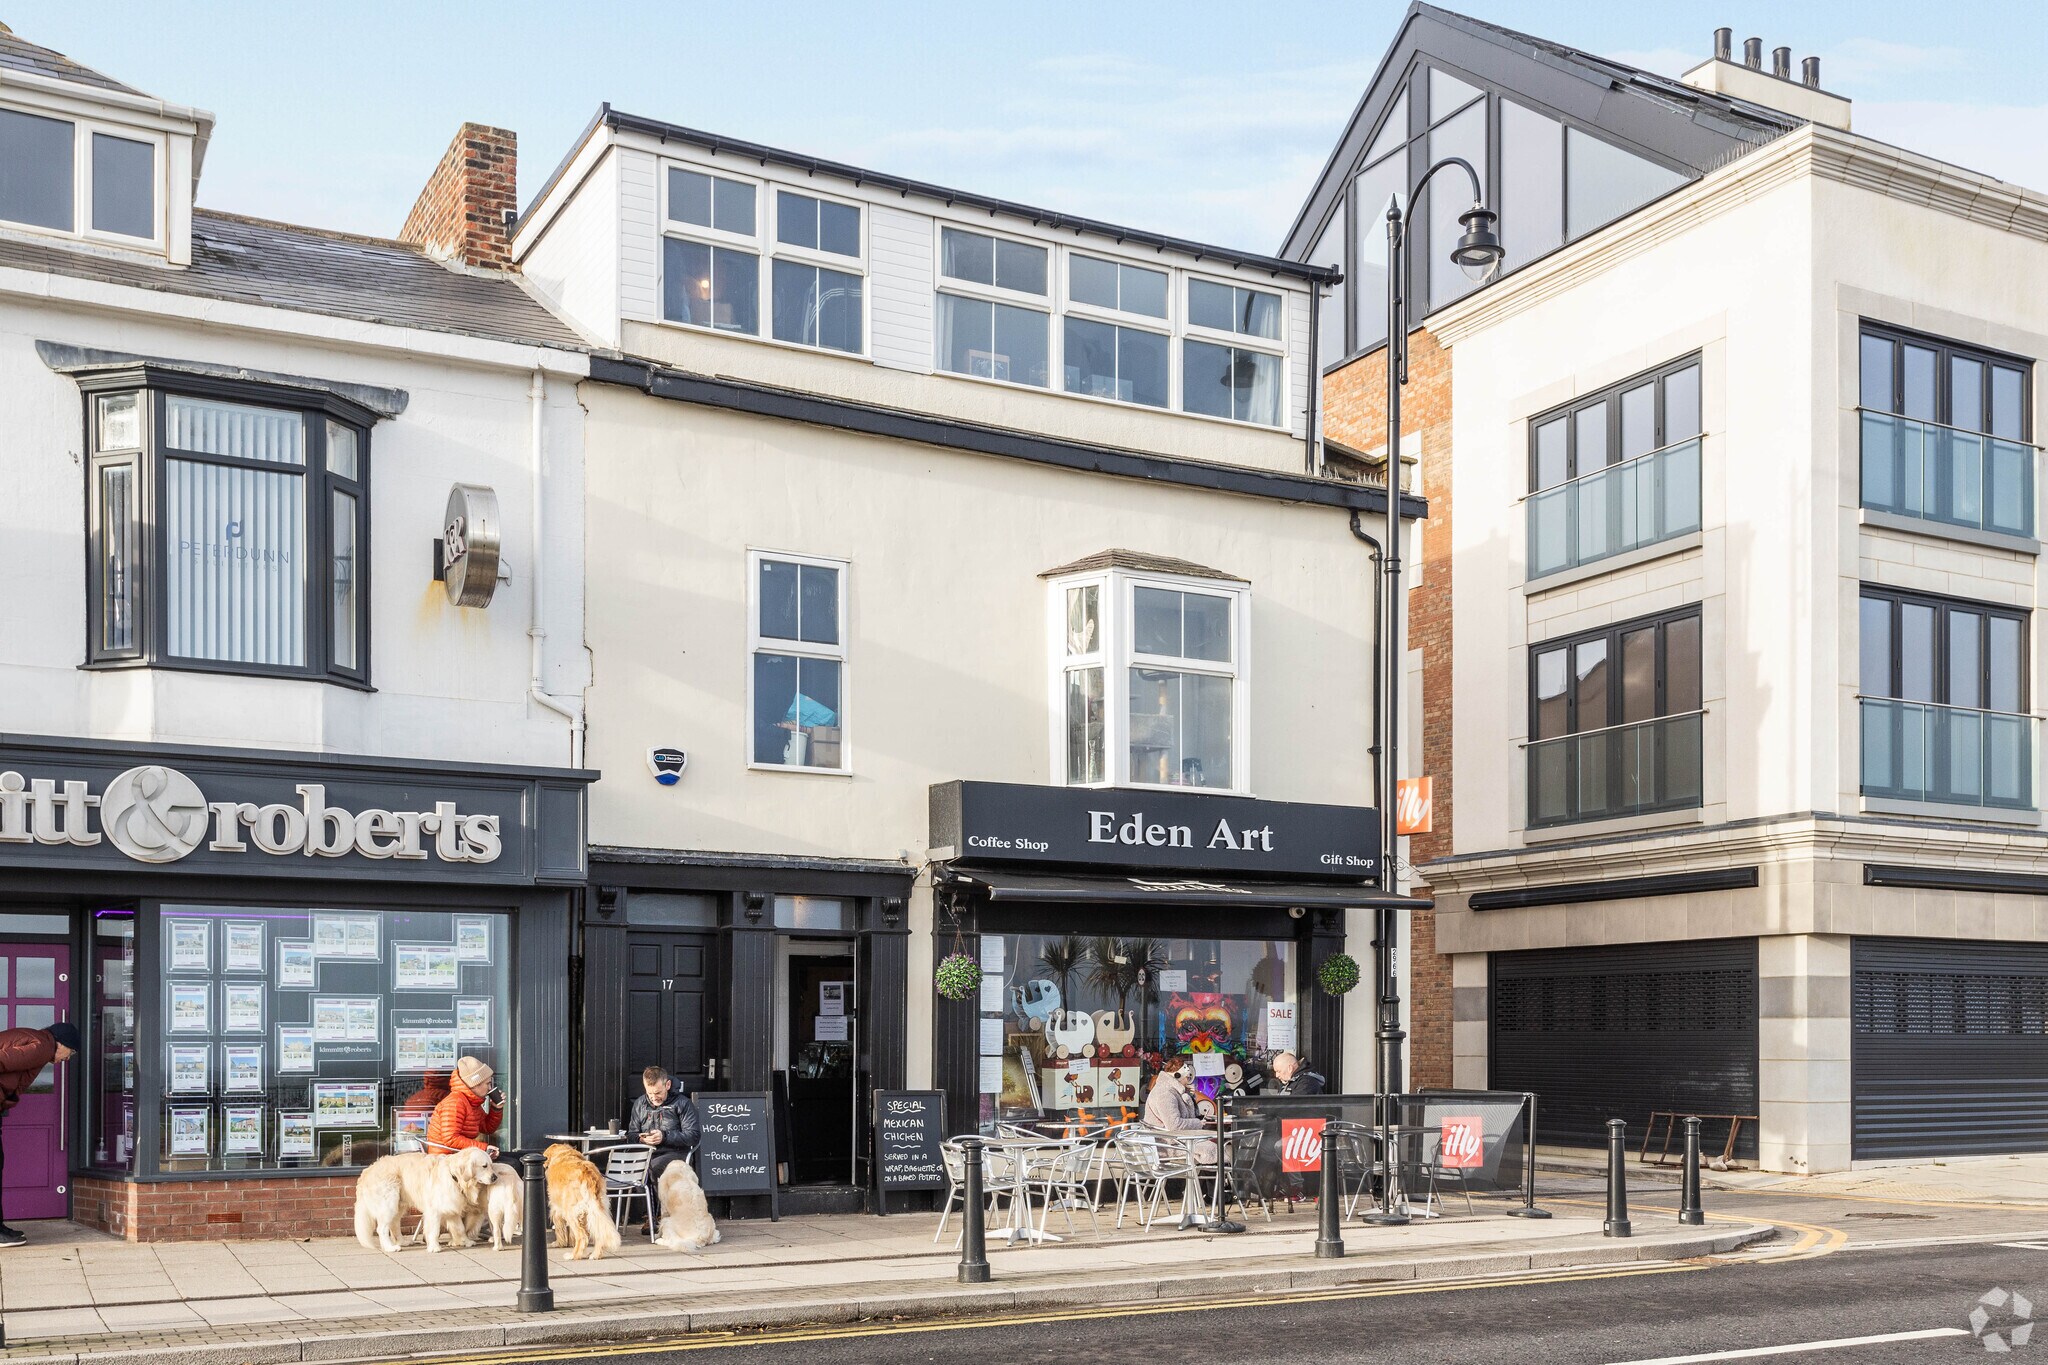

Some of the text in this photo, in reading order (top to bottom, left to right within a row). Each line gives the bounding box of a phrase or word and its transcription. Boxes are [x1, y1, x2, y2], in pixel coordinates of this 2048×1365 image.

[208, 784, 502, 863] roberts
[1087, 810, 1274, 852] Eden Art
[968, 835, 1049, 853] Coffee Shop
[1320, 854, 1374, 869] Gift Shop
[662, 979, 674, 990] 17
[1270, 1008, 1292, 1019] SALE
[707, 1103, 751, 1114] SPECIAL
[887, 1100, 926, 1111] SPECIAL
[702, 1124, 724, 1133] HOG
[883, 1118, 924, 1128] MEXICAN
[722, 1134, 739, 1143] PIE
[883, 1132, 924, 1141] CHICKEN
[1285, 1126, 1322, 1167] illy
[1445, 1124, 1480, 1162] illy
[735, 1152, 759, 1160] WITH
[884, 1153, 908, 1161] SERVED
[921, 1153, 928, 1161] A
[918, 1173, 942, 1181] POTATO
